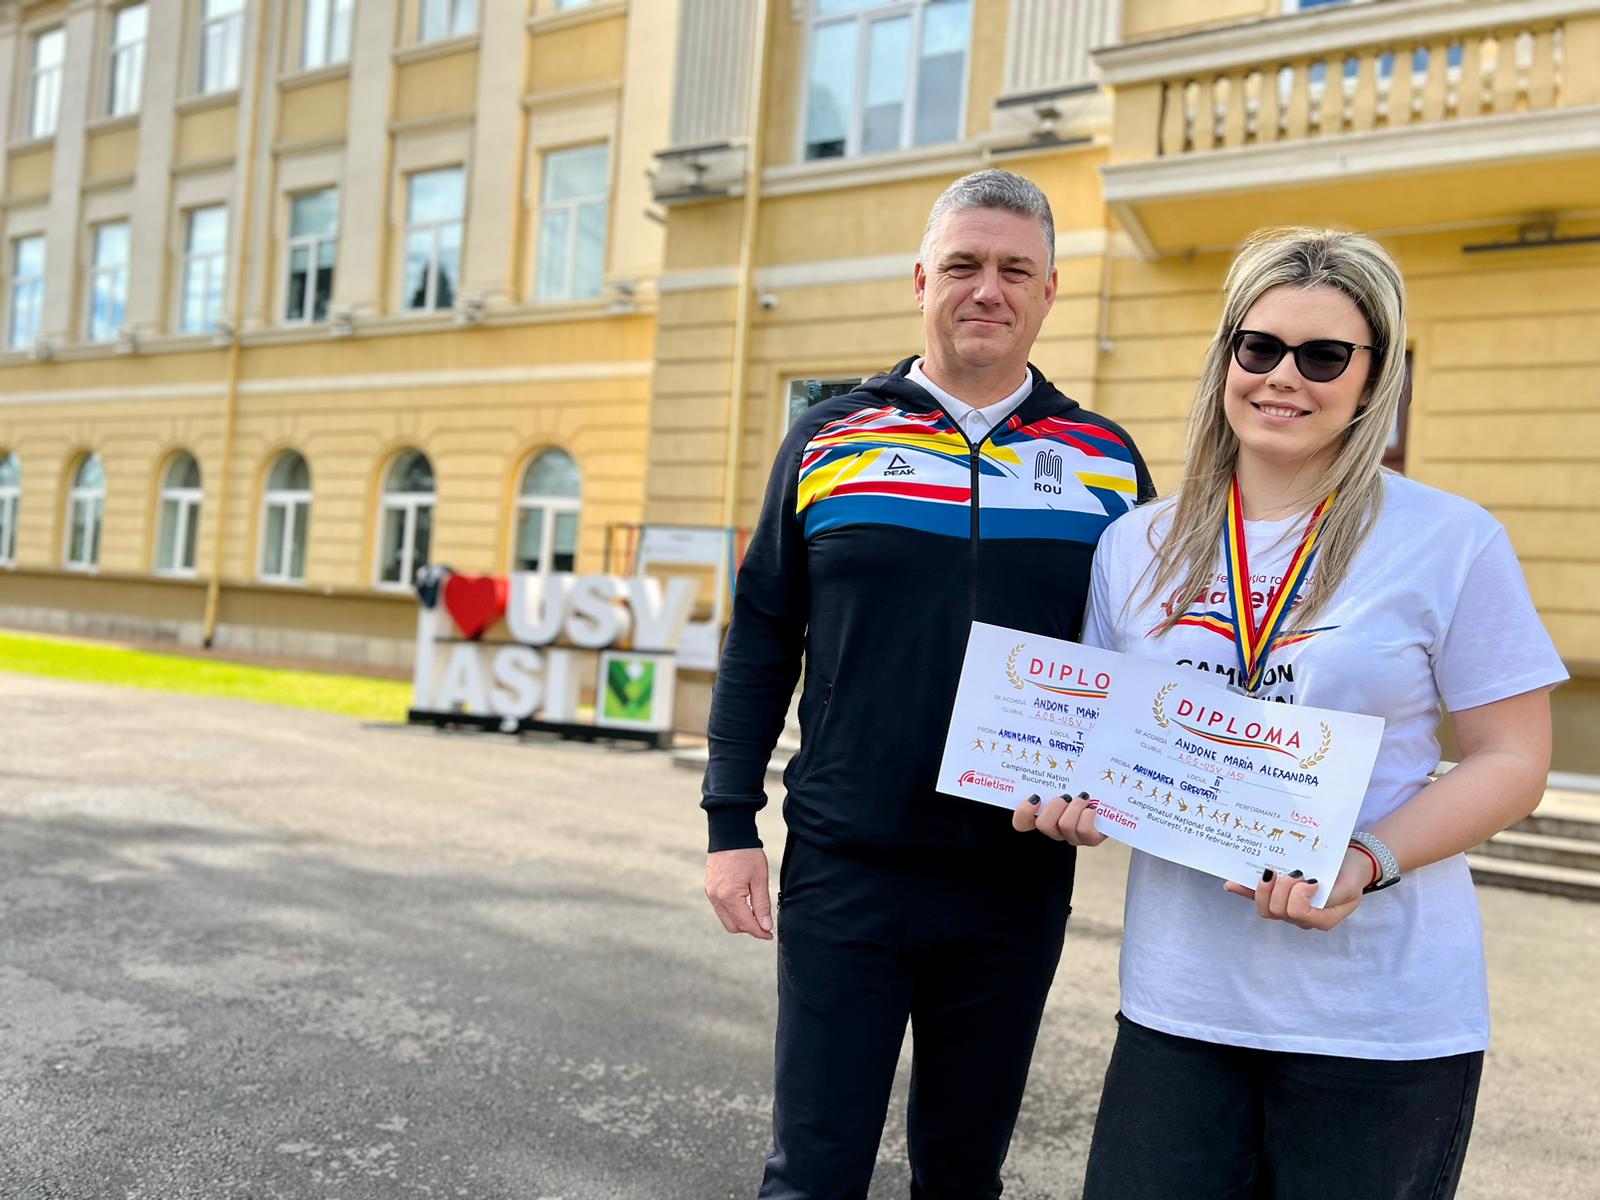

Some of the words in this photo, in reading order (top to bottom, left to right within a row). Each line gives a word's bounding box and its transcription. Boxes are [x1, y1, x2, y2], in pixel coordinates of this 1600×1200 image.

[883, 468, 916, 476] PEAK
[1034, 482, 1062, 495] ROU
[506, 571, 692, 650] USV
[1033, 697, 1070, 713] ANDONE
[977, 725, 998, 735] PROBA
[1176, 698, 1301, 749] DIPLOMA
[1050, 730, 1070, 739] LOCUL
[1000, 761, 1046, 778] Campionatul
[1110, 756, 1132, 769] PROBA
[1175, 738, 1217, 761] ANDONE
[1259, 764, 1320, 788] ALEXANDRA
[974, 776, 1015, 793] atletism
[1186, 773, 1207, 784] LOCUL
[1096, 807, 1138, 830] atletism
[1127, 796, 1174, 820] Campionatul
[1173, 814, 1205, 833] Național
[1205, 824, 1215, 834] de
[1235, 834, 1263, 849] Seniori
[1268, 846, 1287, 857] U23,
[1205, 832, 1241, 851] februarie
[1241, 845, 1261, 857] 2023
